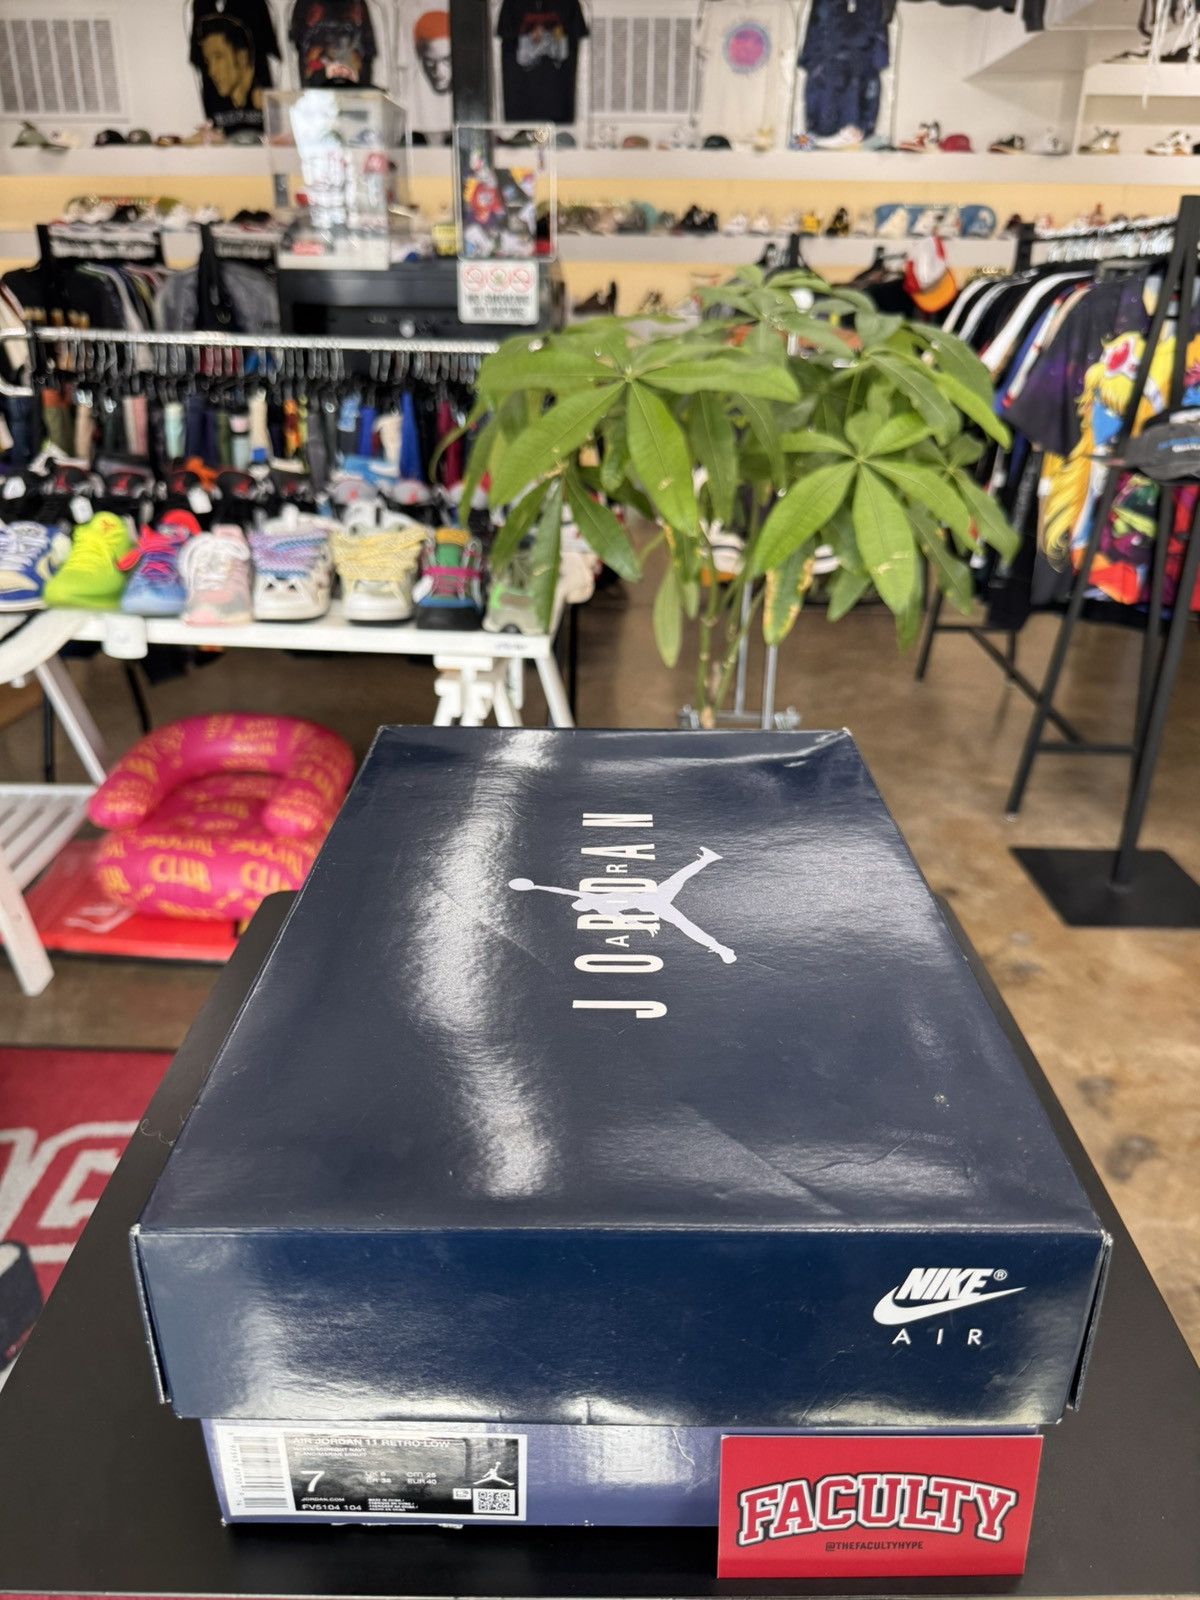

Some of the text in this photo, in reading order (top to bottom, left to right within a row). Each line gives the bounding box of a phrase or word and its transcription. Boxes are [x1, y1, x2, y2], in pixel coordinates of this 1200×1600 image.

[572, 812, 668, 1019] JORDAN
[894, 1267, 995, 1301] NIKE
[891, 1328, 984, 1346] AIR
[317, 1438, 362, 1446] JORDAN
[381, 1440, 420, 1448] RETRO
[423, 1440, 450, 1449] LOW
[301, 1470, 326, 1493] 7
[737, 1472, 1020, 1547] FACULTY
[825, 1541, 924, 1553] @THEFACULTYHYPE
